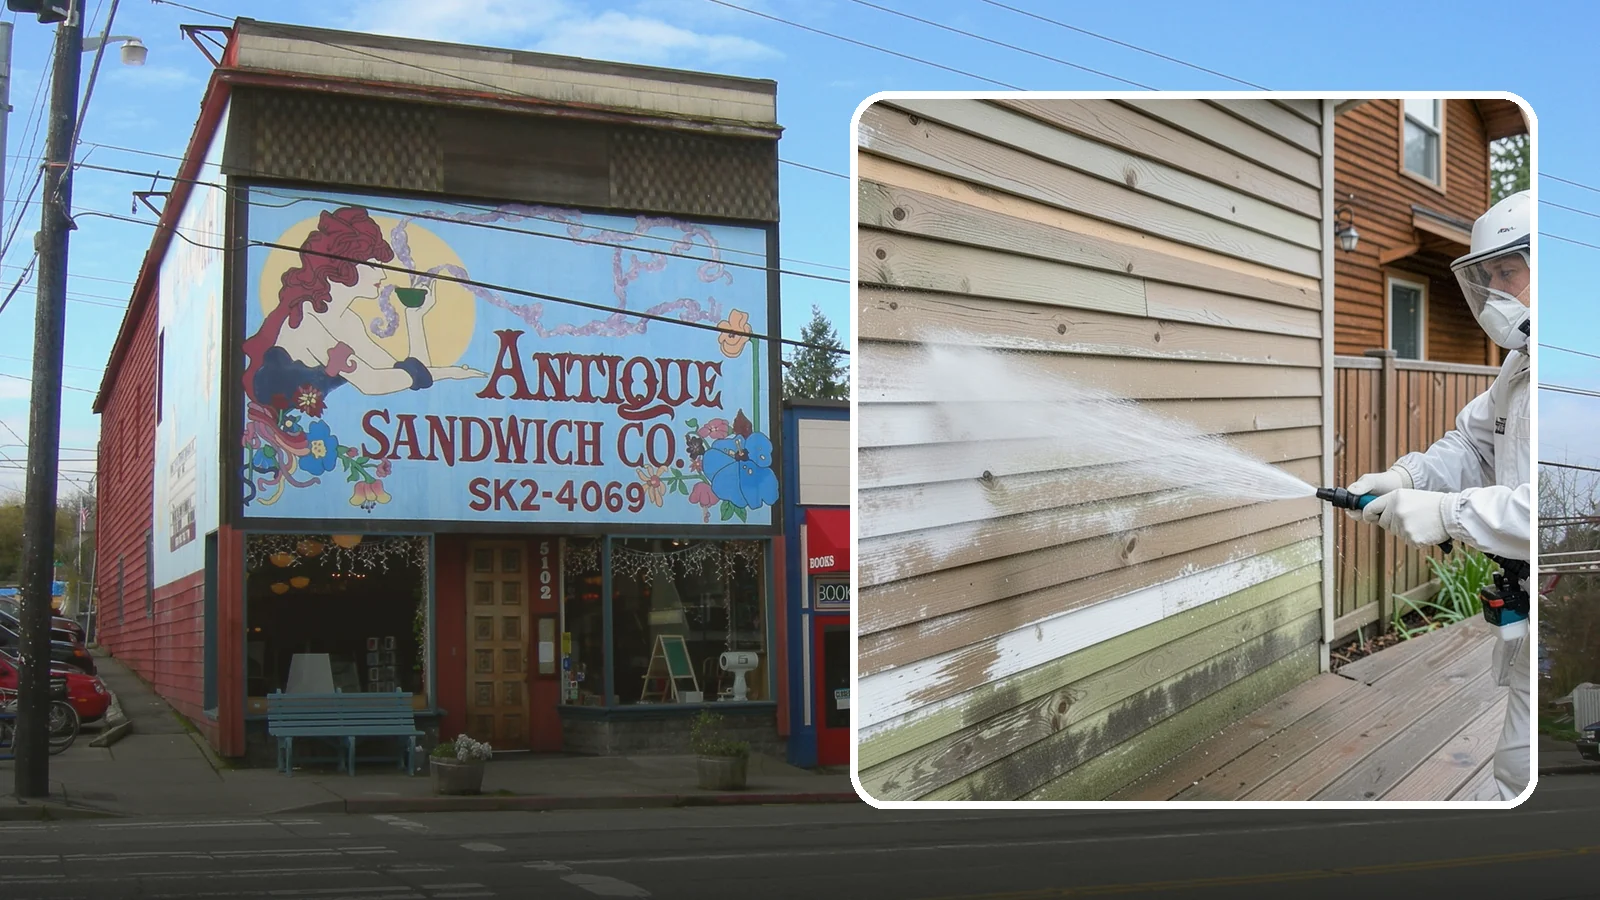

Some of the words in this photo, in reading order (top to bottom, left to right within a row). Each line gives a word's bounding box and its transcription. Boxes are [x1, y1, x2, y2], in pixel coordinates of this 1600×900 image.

[476, 329, 723, 420] ANTIQUE
[362, 408, 605, 467] SANDWICH
[617, 422, 684, 468] CO.
[467, 477, 646, 512] SK2-4069
[540, 541, 551, 600] 5102
[809, 555, 835, 569] BOOKS
